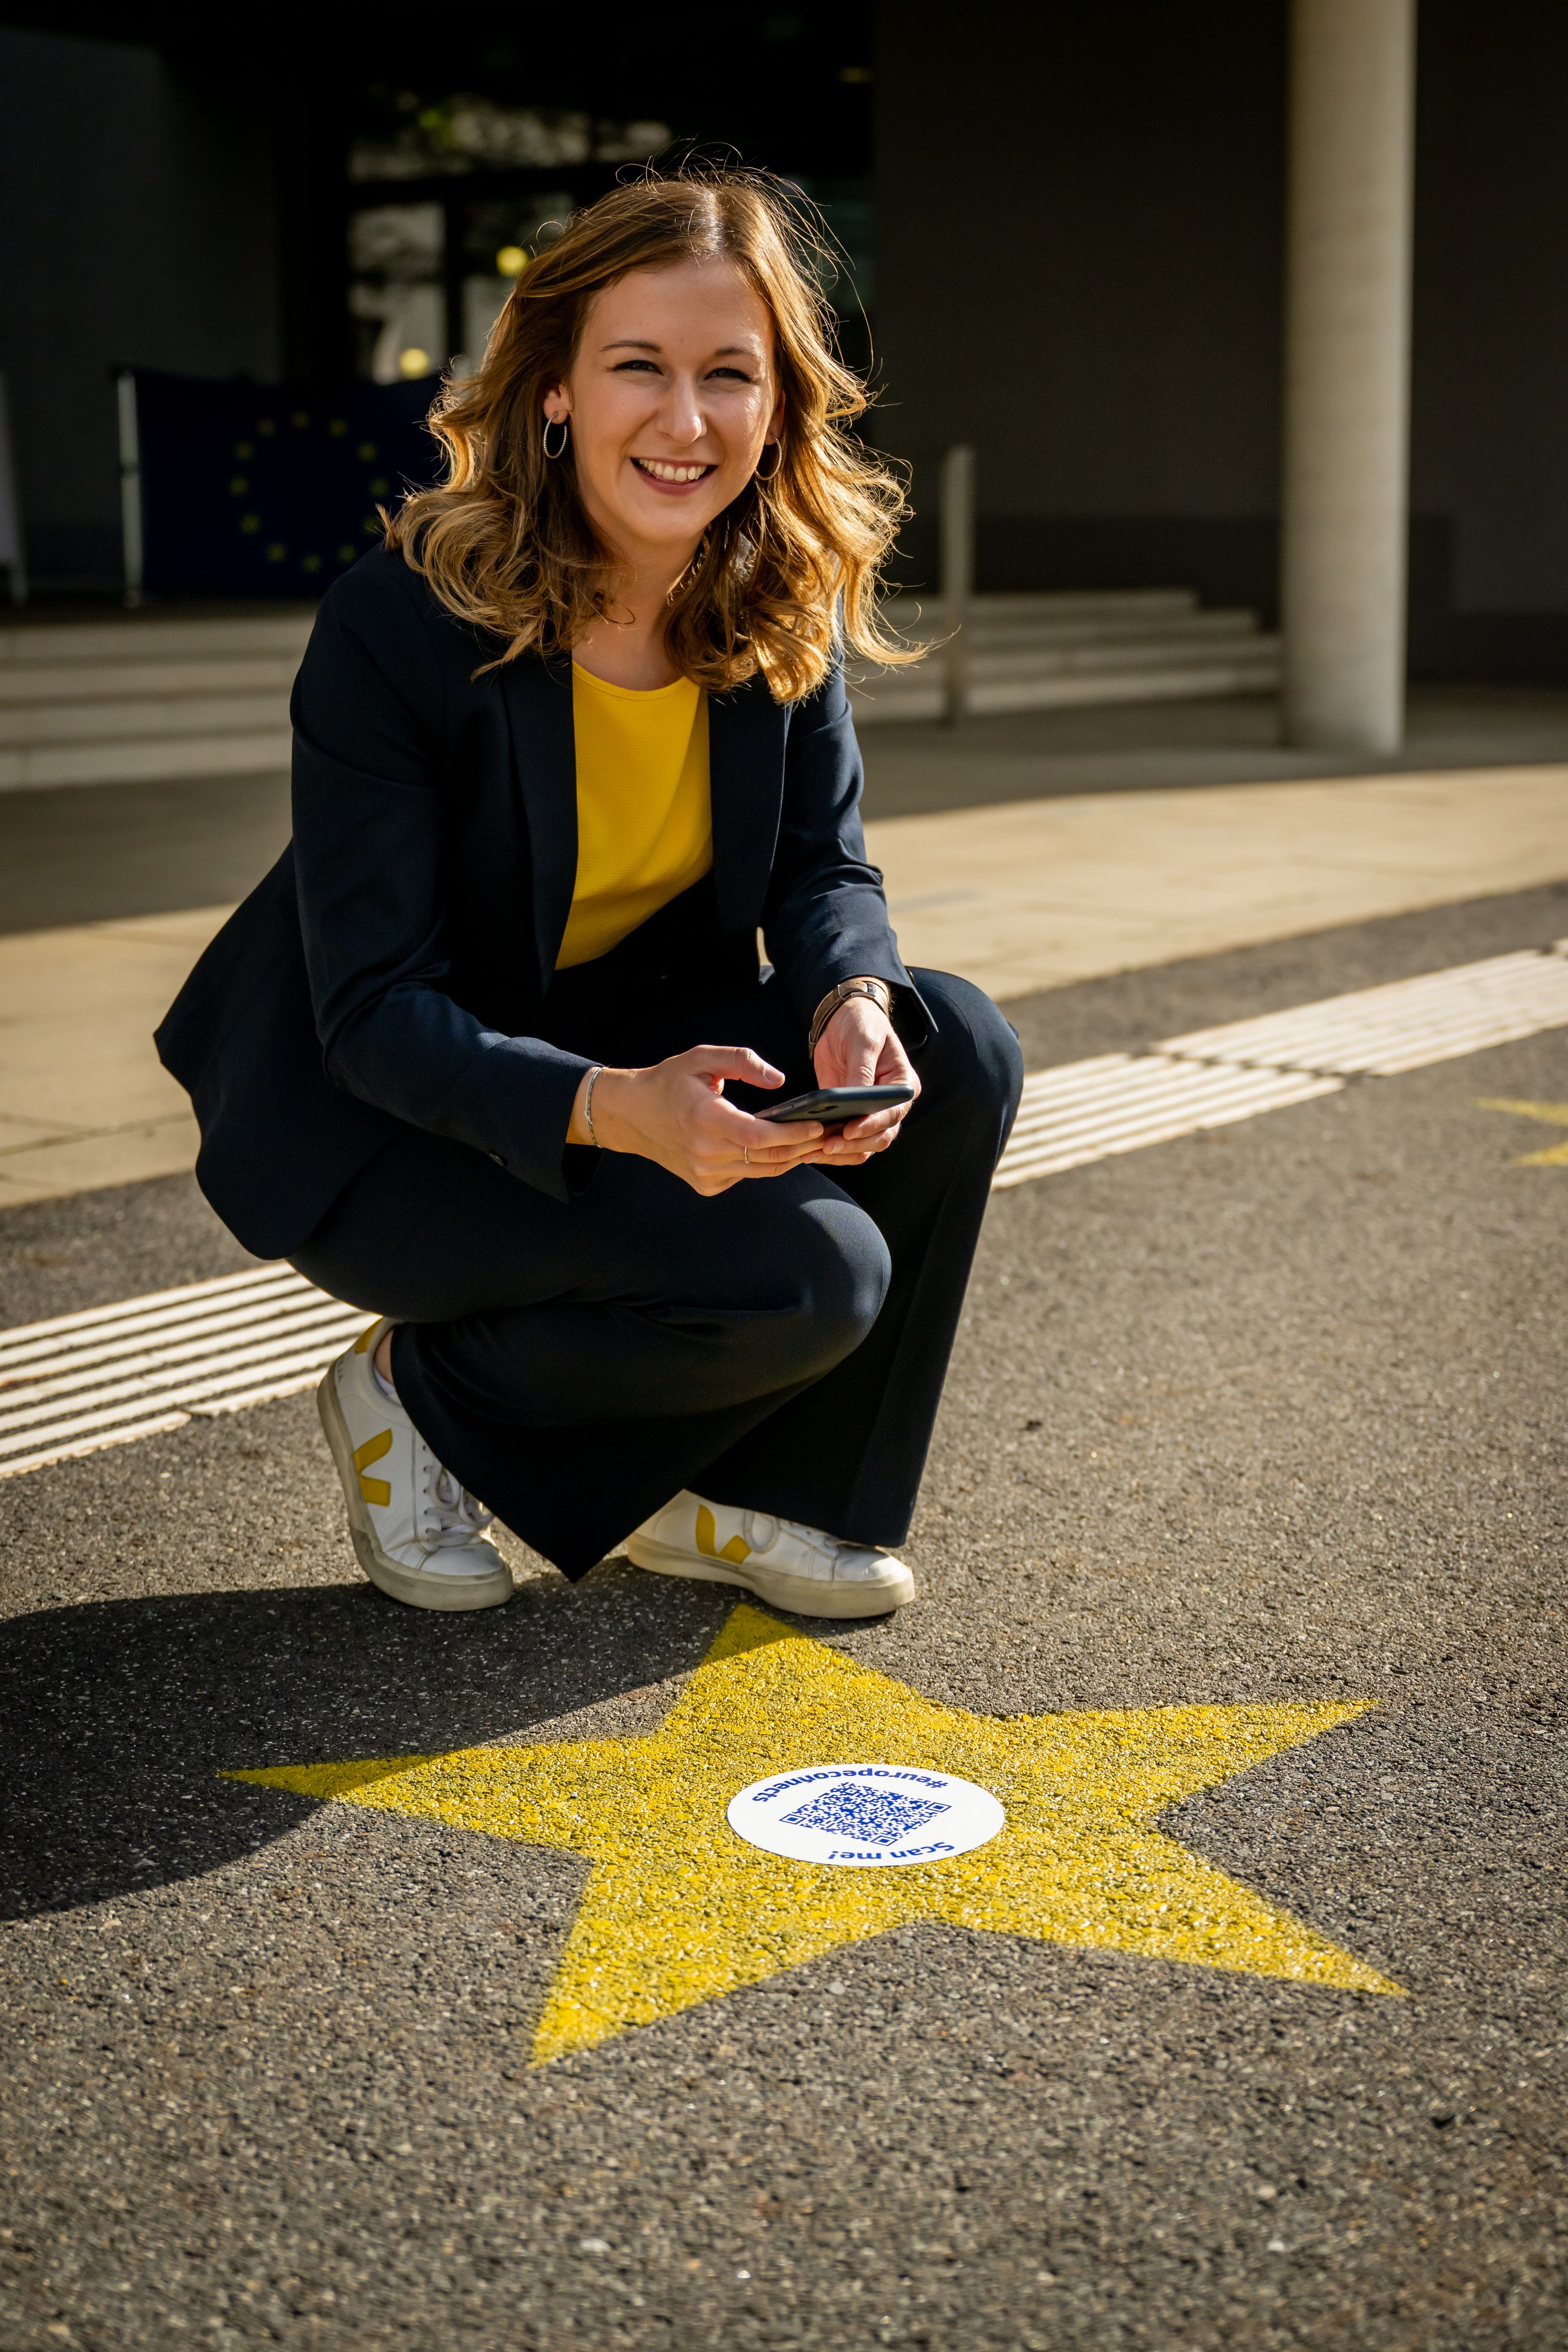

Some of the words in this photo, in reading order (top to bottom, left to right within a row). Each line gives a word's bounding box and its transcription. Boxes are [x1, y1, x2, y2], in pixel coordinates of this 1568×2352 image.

[752, 1768, 948, 1803] #europeconnects
[828, 1850, 882, 1860] me!
[890, 1842, 955, 1859] Scan
